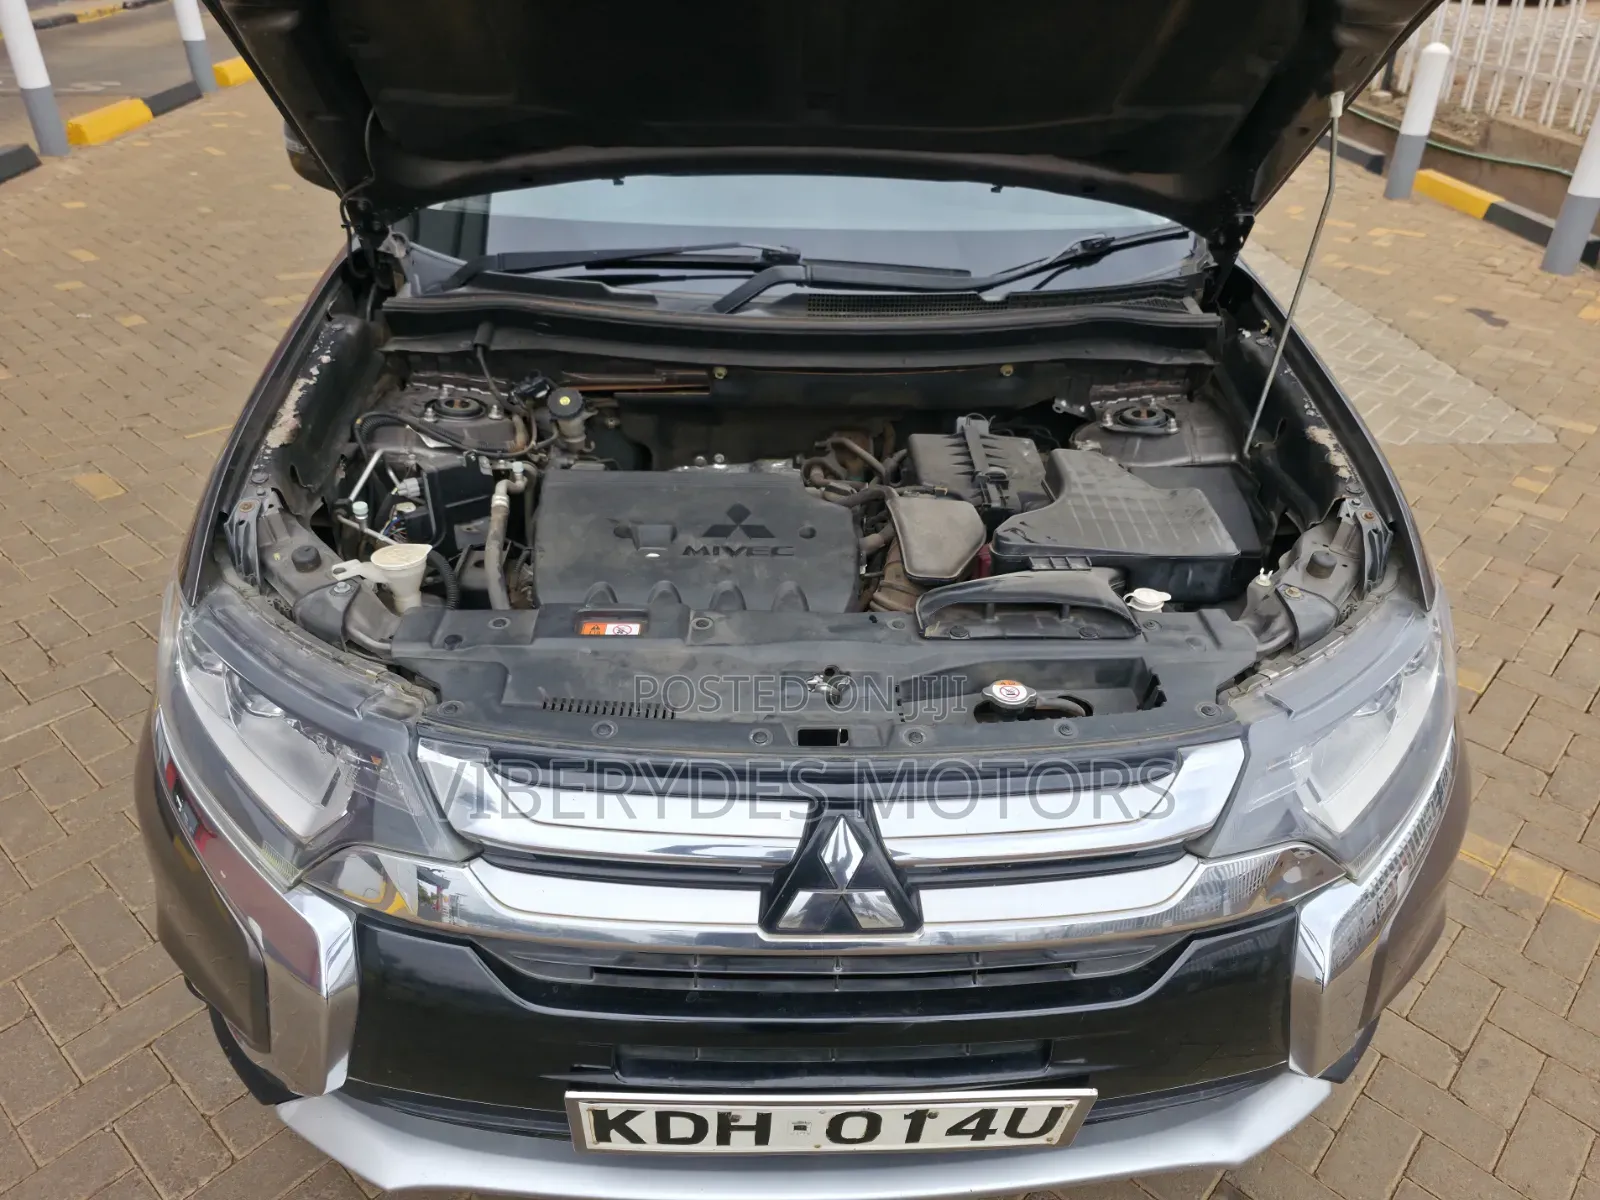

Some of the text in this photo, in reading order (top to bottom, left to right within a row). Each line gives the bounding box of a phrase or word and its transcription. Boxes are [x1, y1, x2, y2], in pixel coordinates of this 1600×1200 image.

[682, 545, 795, 557] MIVEC
[594, 1106, 1065, 1147] KDH 014U
